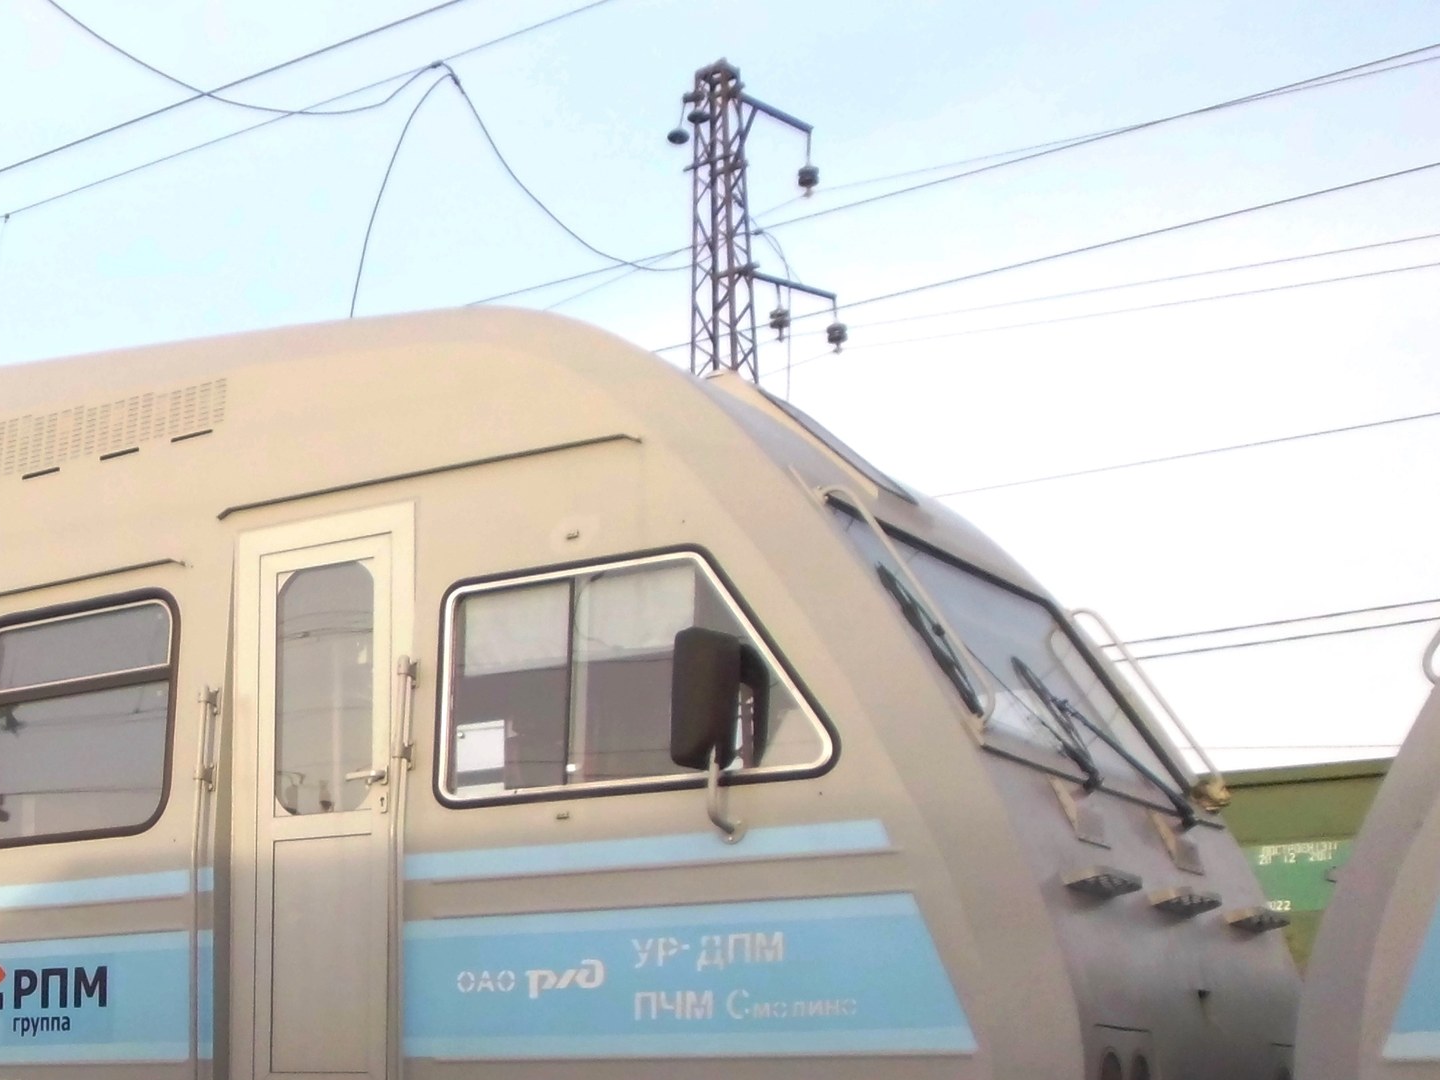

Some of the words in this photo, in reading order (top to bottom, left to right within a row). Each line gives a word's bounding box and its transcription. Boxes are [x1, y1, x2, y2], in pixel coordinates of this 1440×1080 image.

[14, 966, 107, 1009] РПМ
[457, 970, 515, 993] ОАО
[634, 990, 713, 1021] ПЧМ
[13, 1016, 71, 1037] группа
